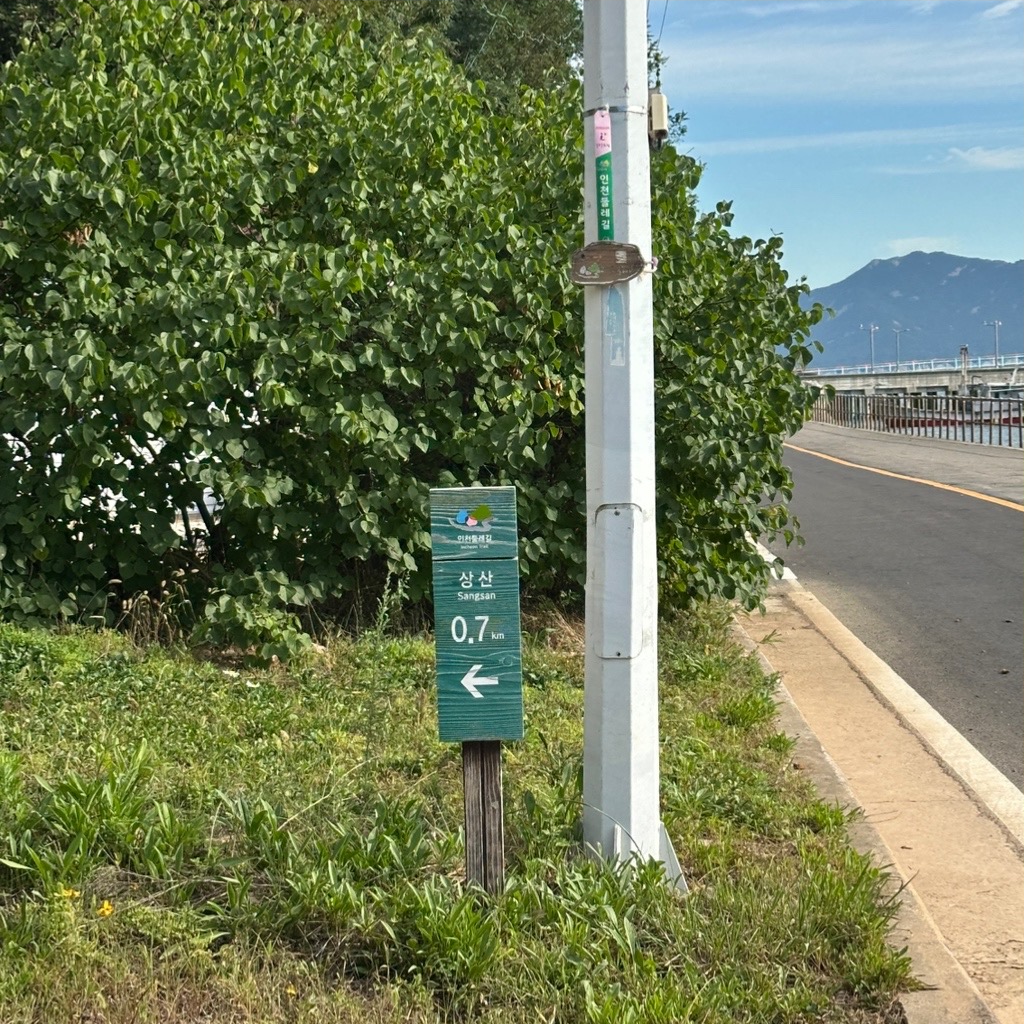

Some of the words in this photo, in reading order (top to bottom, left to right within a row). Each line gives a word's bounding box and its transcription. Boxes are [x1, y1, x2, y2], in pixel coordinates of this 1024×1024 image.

[599, 174, 610, 230] 인천둘레길
[459, 571, 493, 588] 상산
[457, 591, 496, 601] Sangsan
[450, 615, 490, 644] 0.7
[491, 631, 505, 640] km
